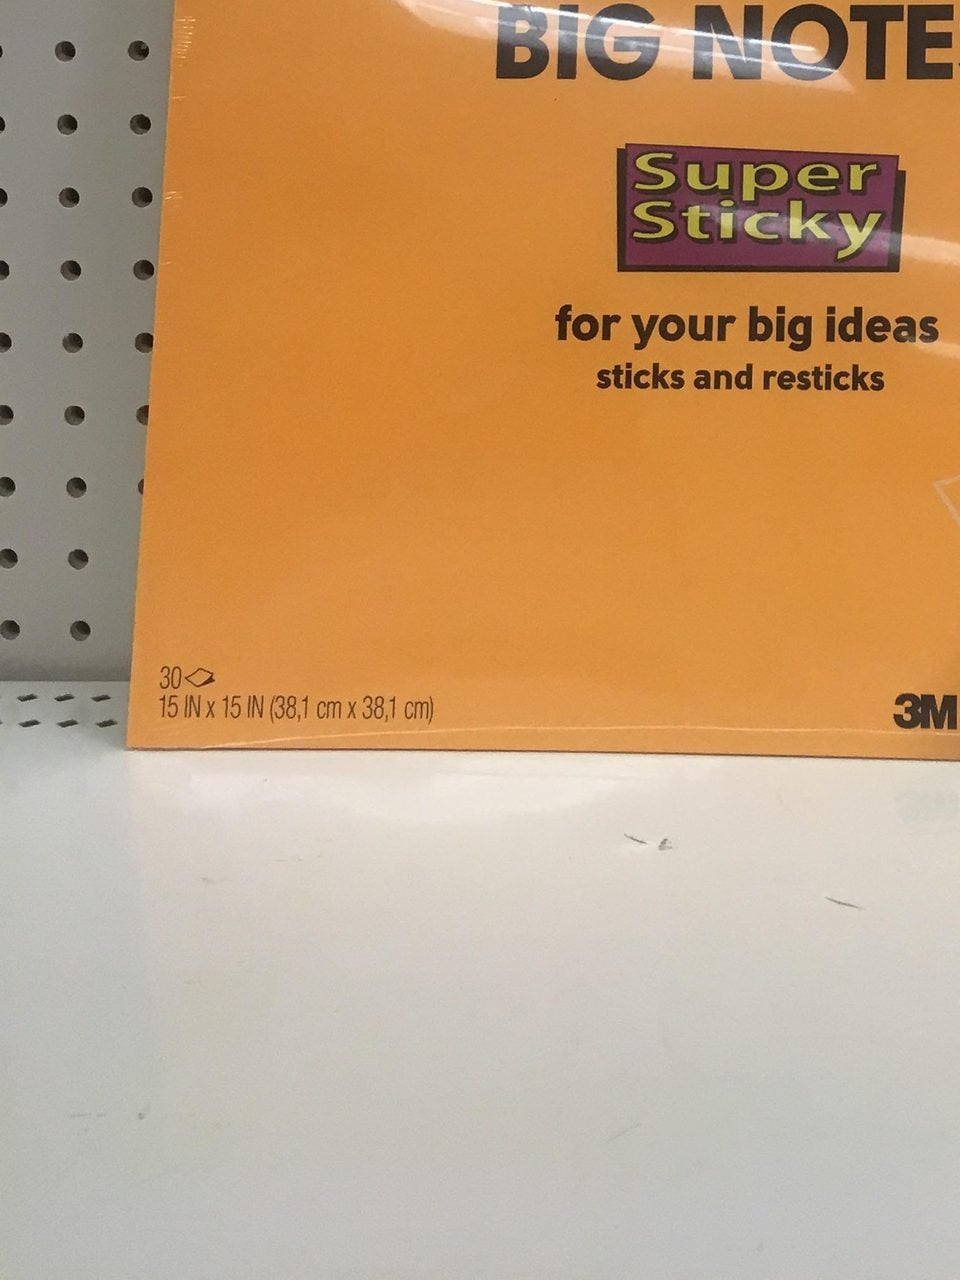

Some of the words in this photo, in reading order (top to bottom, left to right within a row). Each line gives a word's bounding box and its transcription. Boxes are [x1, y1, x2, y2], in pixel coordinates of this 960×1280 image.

[495, 3, 658, 82] BIG
[633, 151, 879, 202] Super
[632, 198, 883, 261] Sticky
[555, 304, 621, 342] for
[632, 310, 737, 350] your
[748, 305, 813, 352] big
[825, 306, 940, 344] ideas
[596, 362, 685, 390] sticks
[693, 364, 753, 390] and
[763, 364, 886, 392] resticks
[159, 665, 182, 689] 30
[158, 694, 179, 719] 15
[183, 694, 202, 719] IN
[206, 700, 215, 719] x
[222, 695, 242, 719] 15
[247, 694, 264, 719] IN
[269, 694, 309, 724] (38,1
[316, 699, 342, 719] cm
[347, 700, 357, 719] x
[361, 695, 397, 722] 38,1
[403, 695, 434, 724] cm)
[893, 692, 958, 730] 3M
